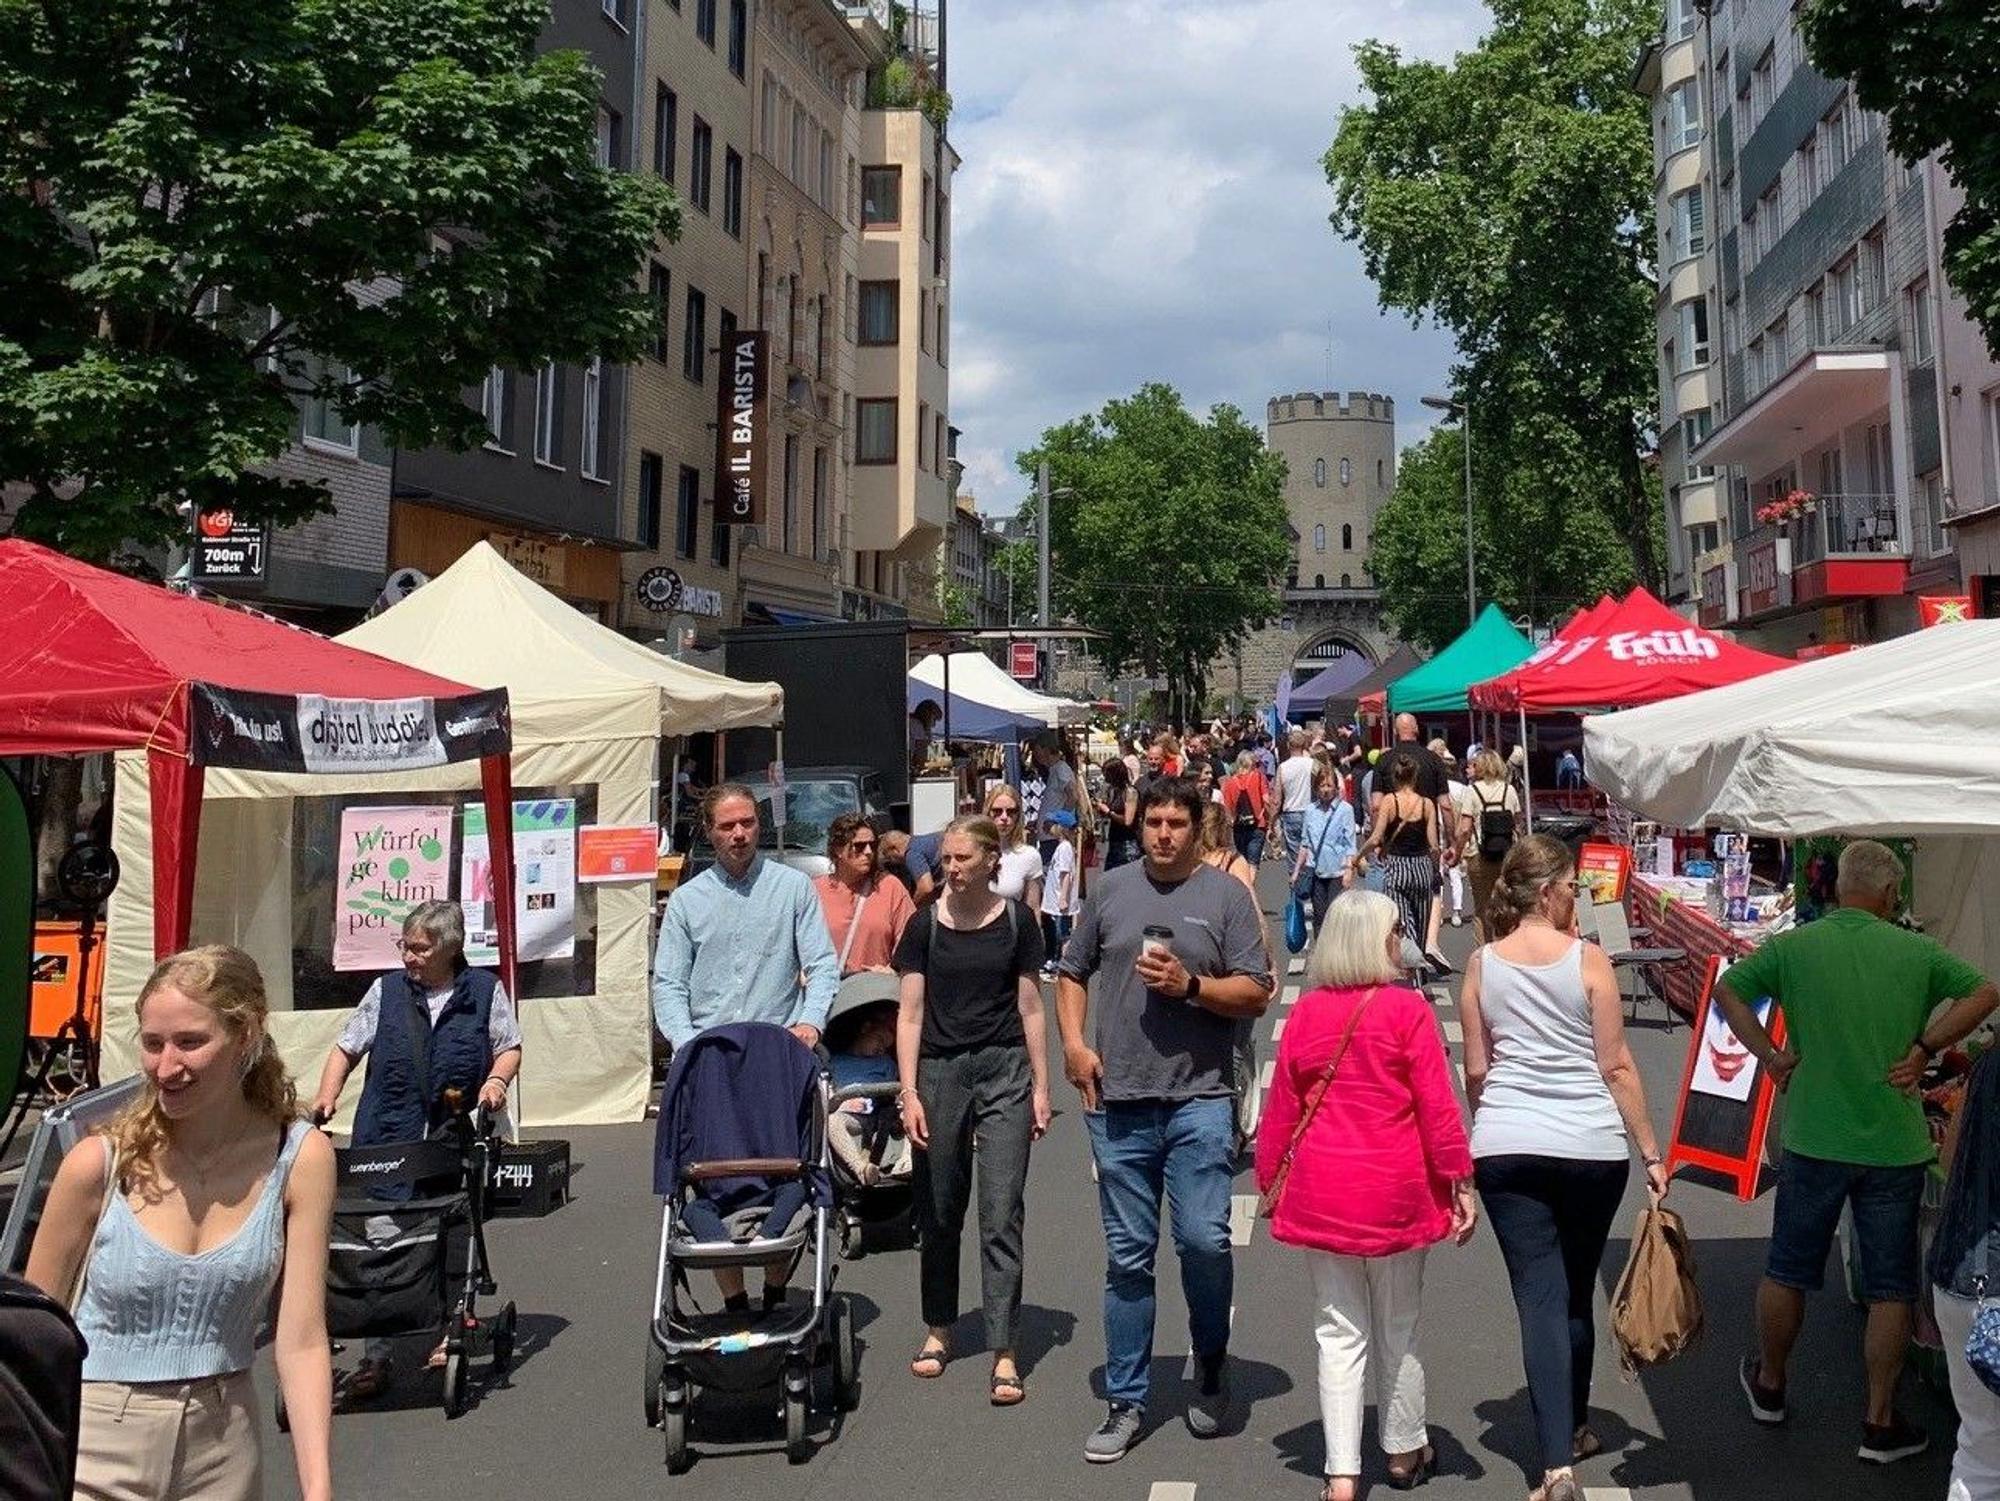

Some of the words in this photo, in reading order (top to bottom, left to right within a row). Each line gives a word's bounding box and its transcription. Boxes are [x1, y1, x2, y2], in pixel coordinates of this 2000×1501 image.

[732, 340, 755, 443] BARISTA
[731, 450, 751, 471] IL
[734, 479, 750, 515] Café
[204, 549, 245, 562] 700m
[206, 563, 241, 573] Zurück
[311, 711, 364, 753] digital
[349, 857, 379, 884] ge
[381, 879, 434, 902] klim
